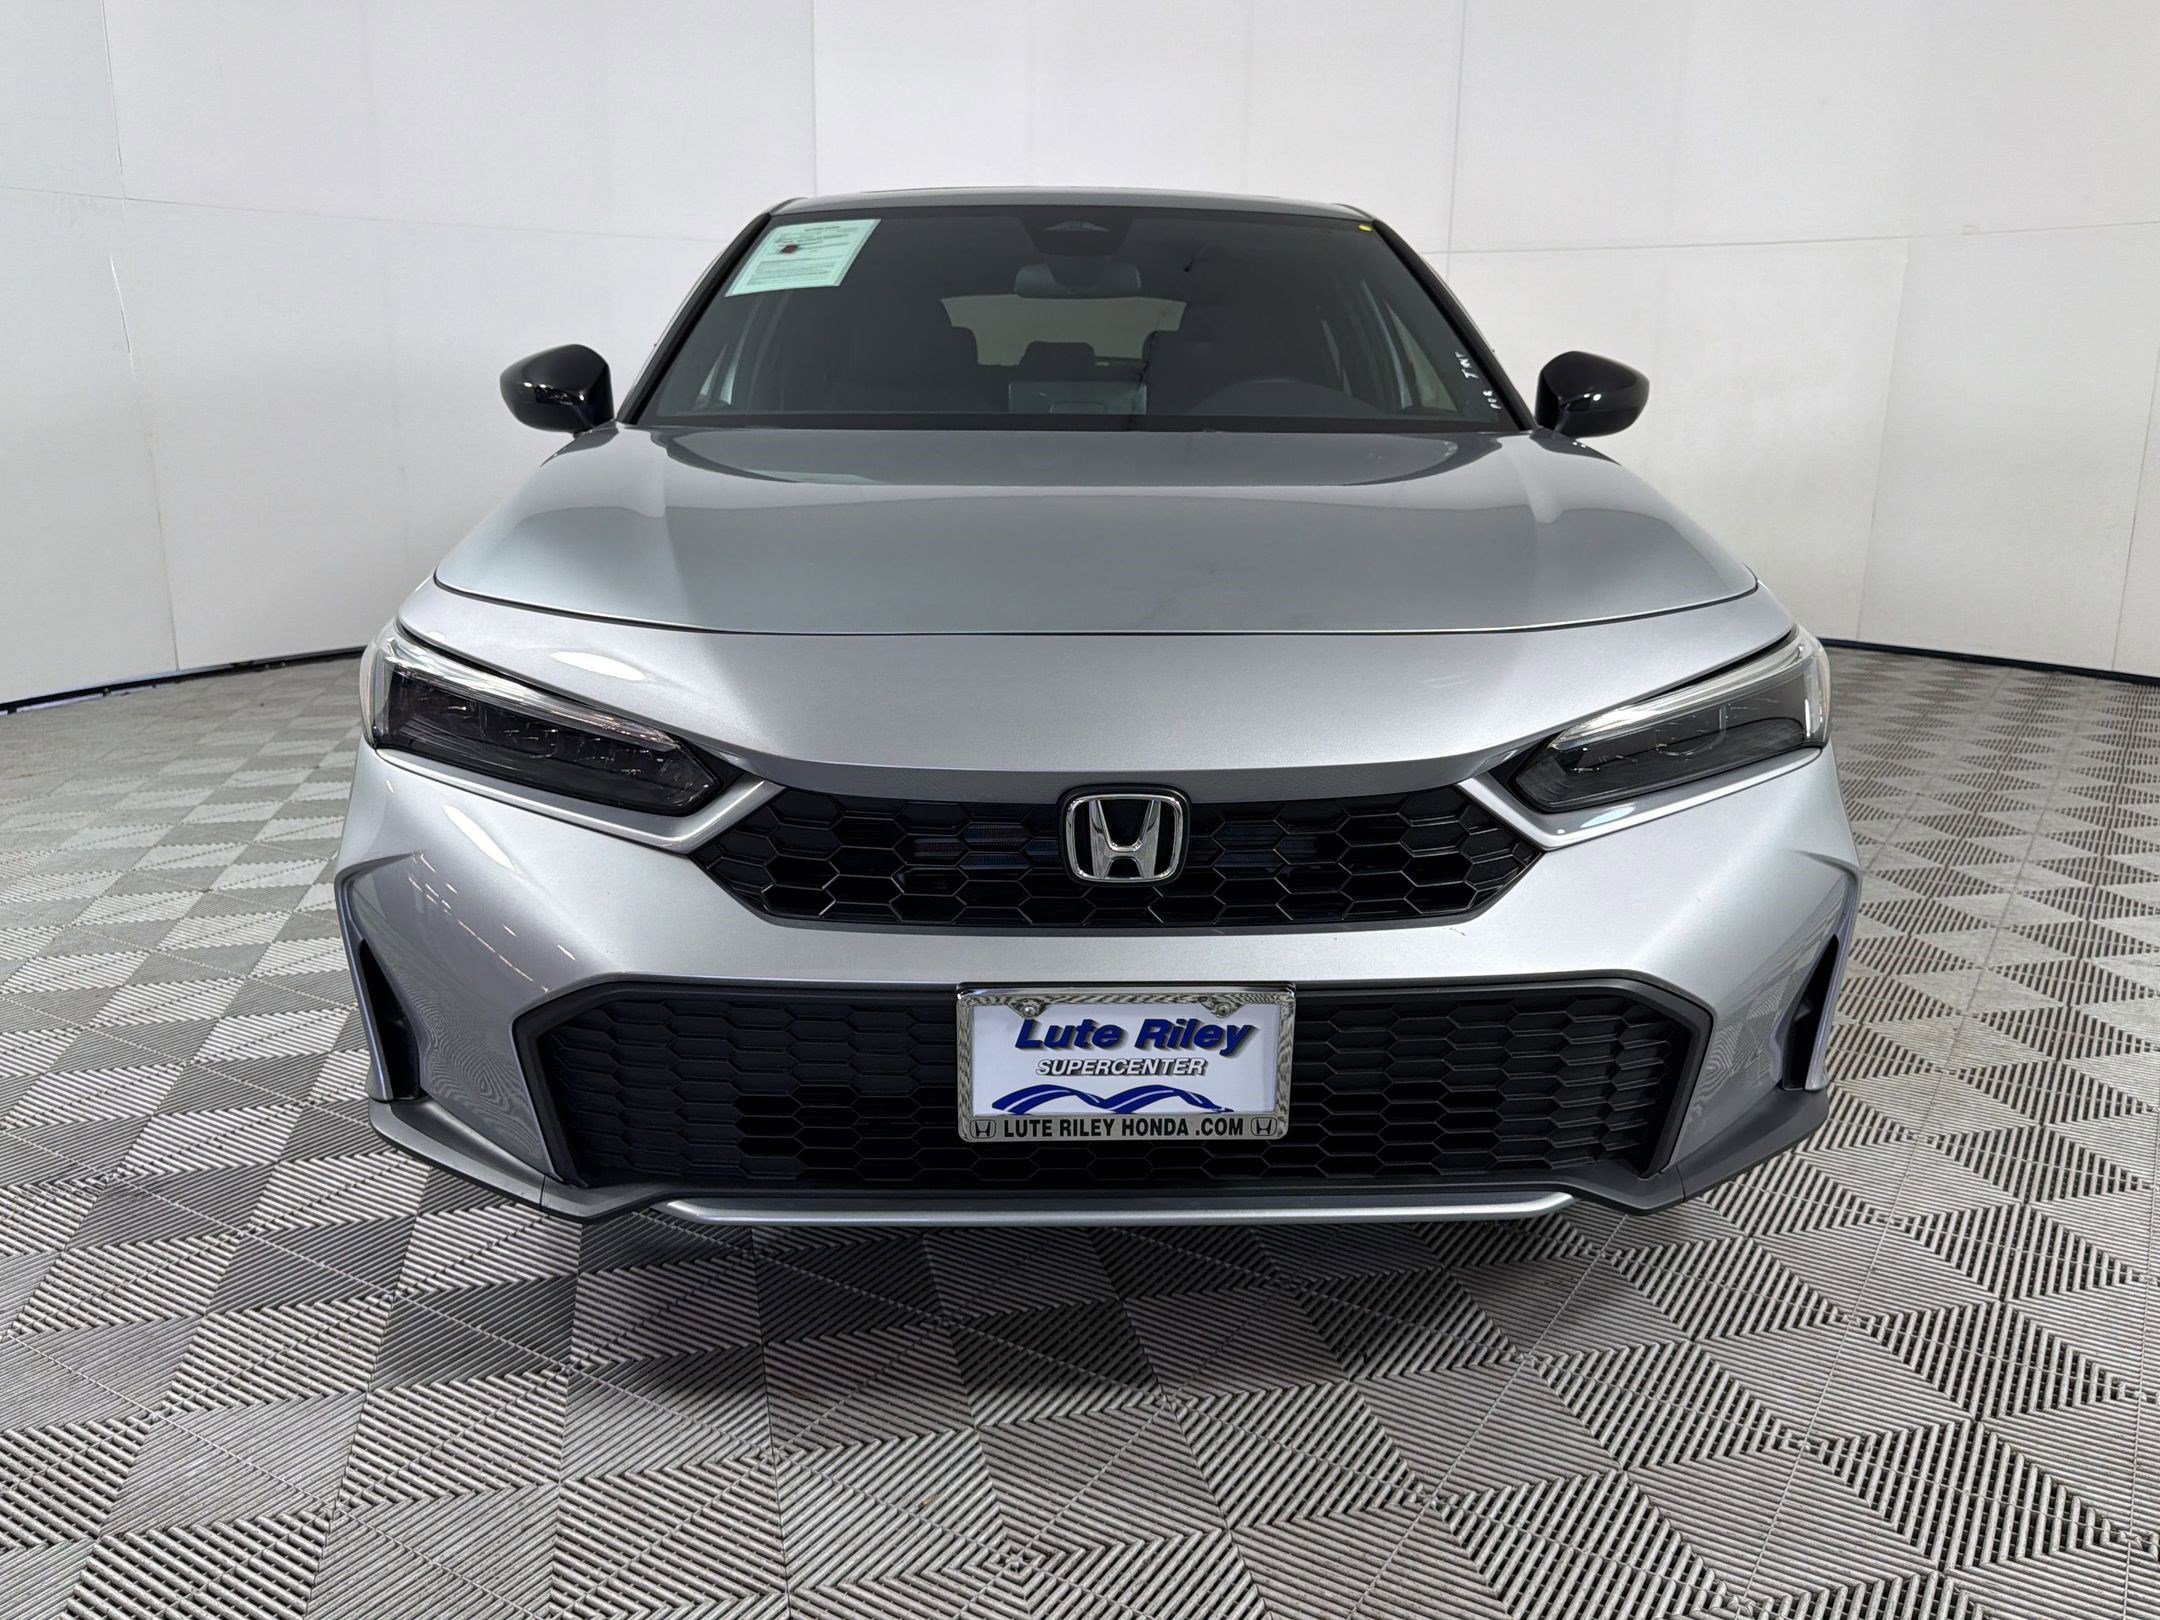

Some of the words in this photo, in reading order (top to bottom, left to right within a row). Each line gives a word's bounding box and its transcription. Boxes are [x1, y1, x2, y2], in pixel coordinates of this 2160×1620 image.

[1014, 1018, 1125, 1051] Lute
[1134, 1017, 1256, 1058] Riley
[1035, 1057, 1208, 1077] SUPERCENTER
[1003, 1118, 1053, 1138] LUTE
[1059, 1118, 1116, 1137] RILEY
[1121, 1117, 1190, 1137] HONDA
[1195, 1117, 1244, 1137] .COM
